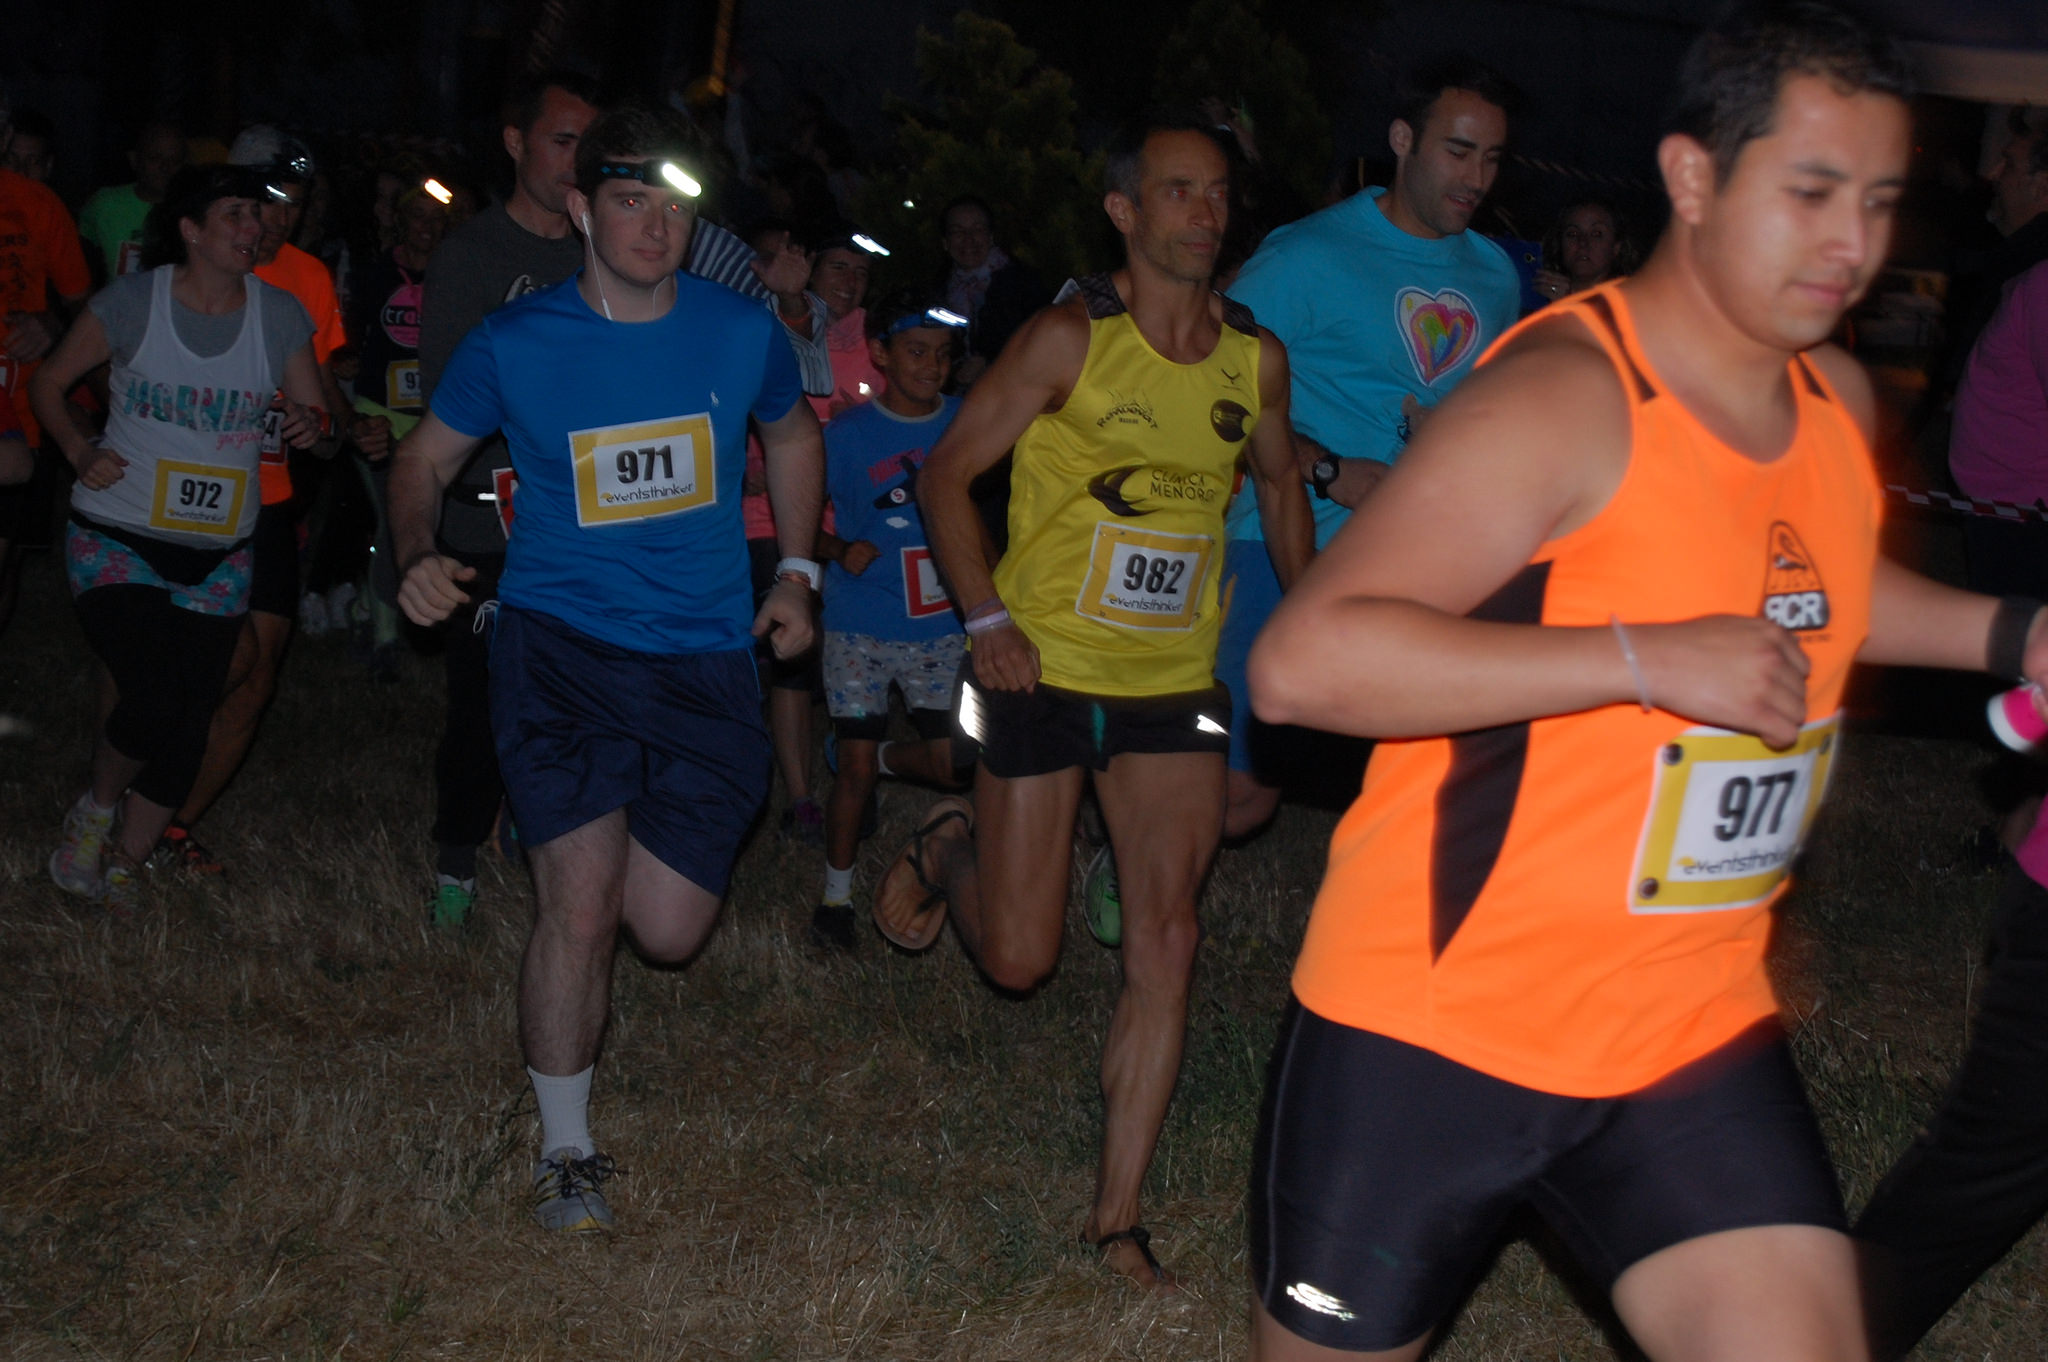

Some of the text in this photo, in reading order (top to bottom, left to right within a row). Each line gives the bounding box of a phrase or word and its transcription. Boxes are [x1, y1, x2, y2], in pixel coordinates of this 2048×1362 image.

[616, 444, 673, 484] 971
[180, 479, 222, 508] 972
[605, 482, 694, 503] eventsthinker
[1123, 553, 1185, 593] 982
[1714, 770, 1797, 842] 977
